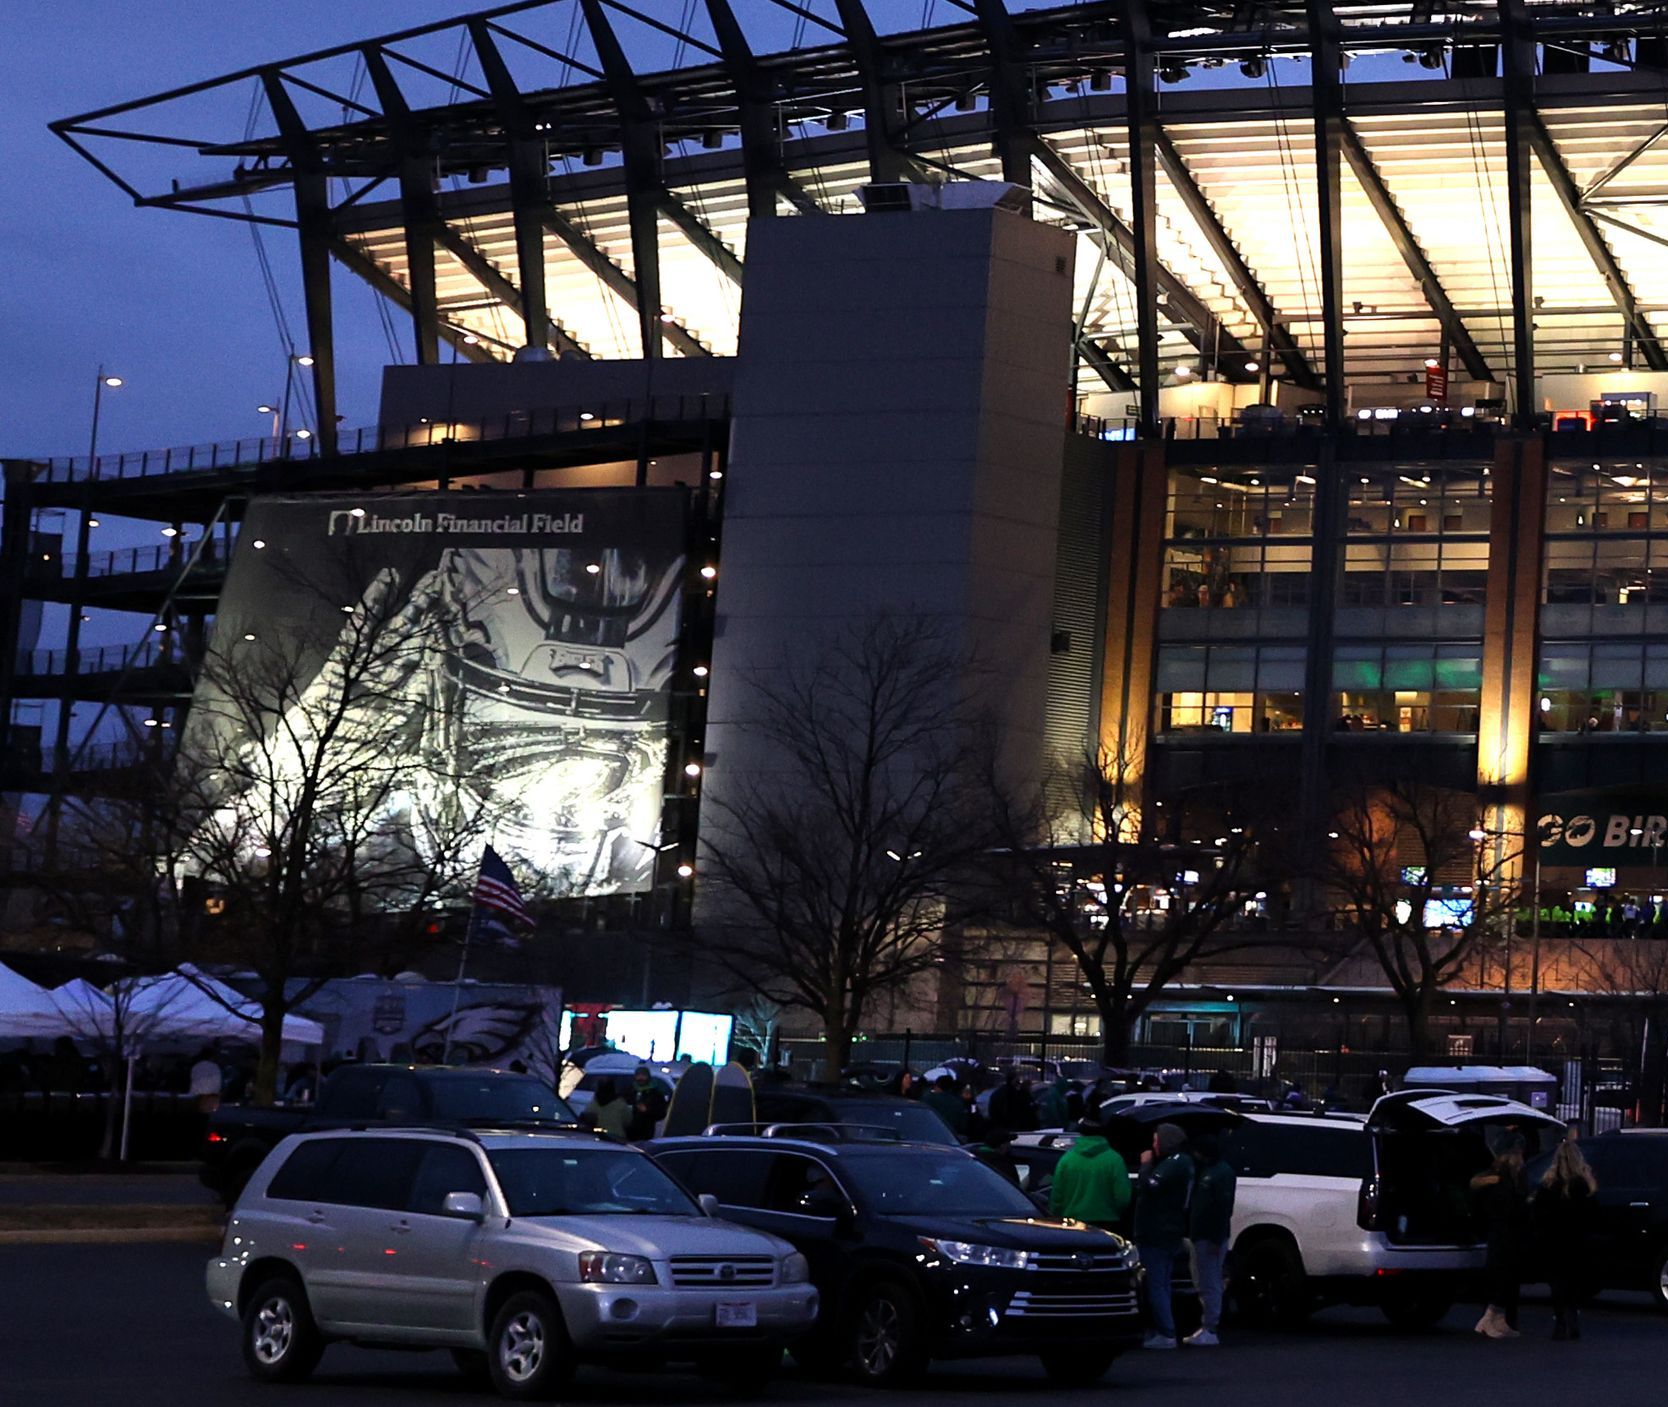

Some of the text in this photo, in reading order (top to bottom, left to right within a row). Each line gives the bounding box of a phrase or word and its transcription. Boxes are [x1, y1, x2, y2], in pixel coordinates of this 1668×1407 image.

[357, 513, 584, 534] Lincoln Financial Field
